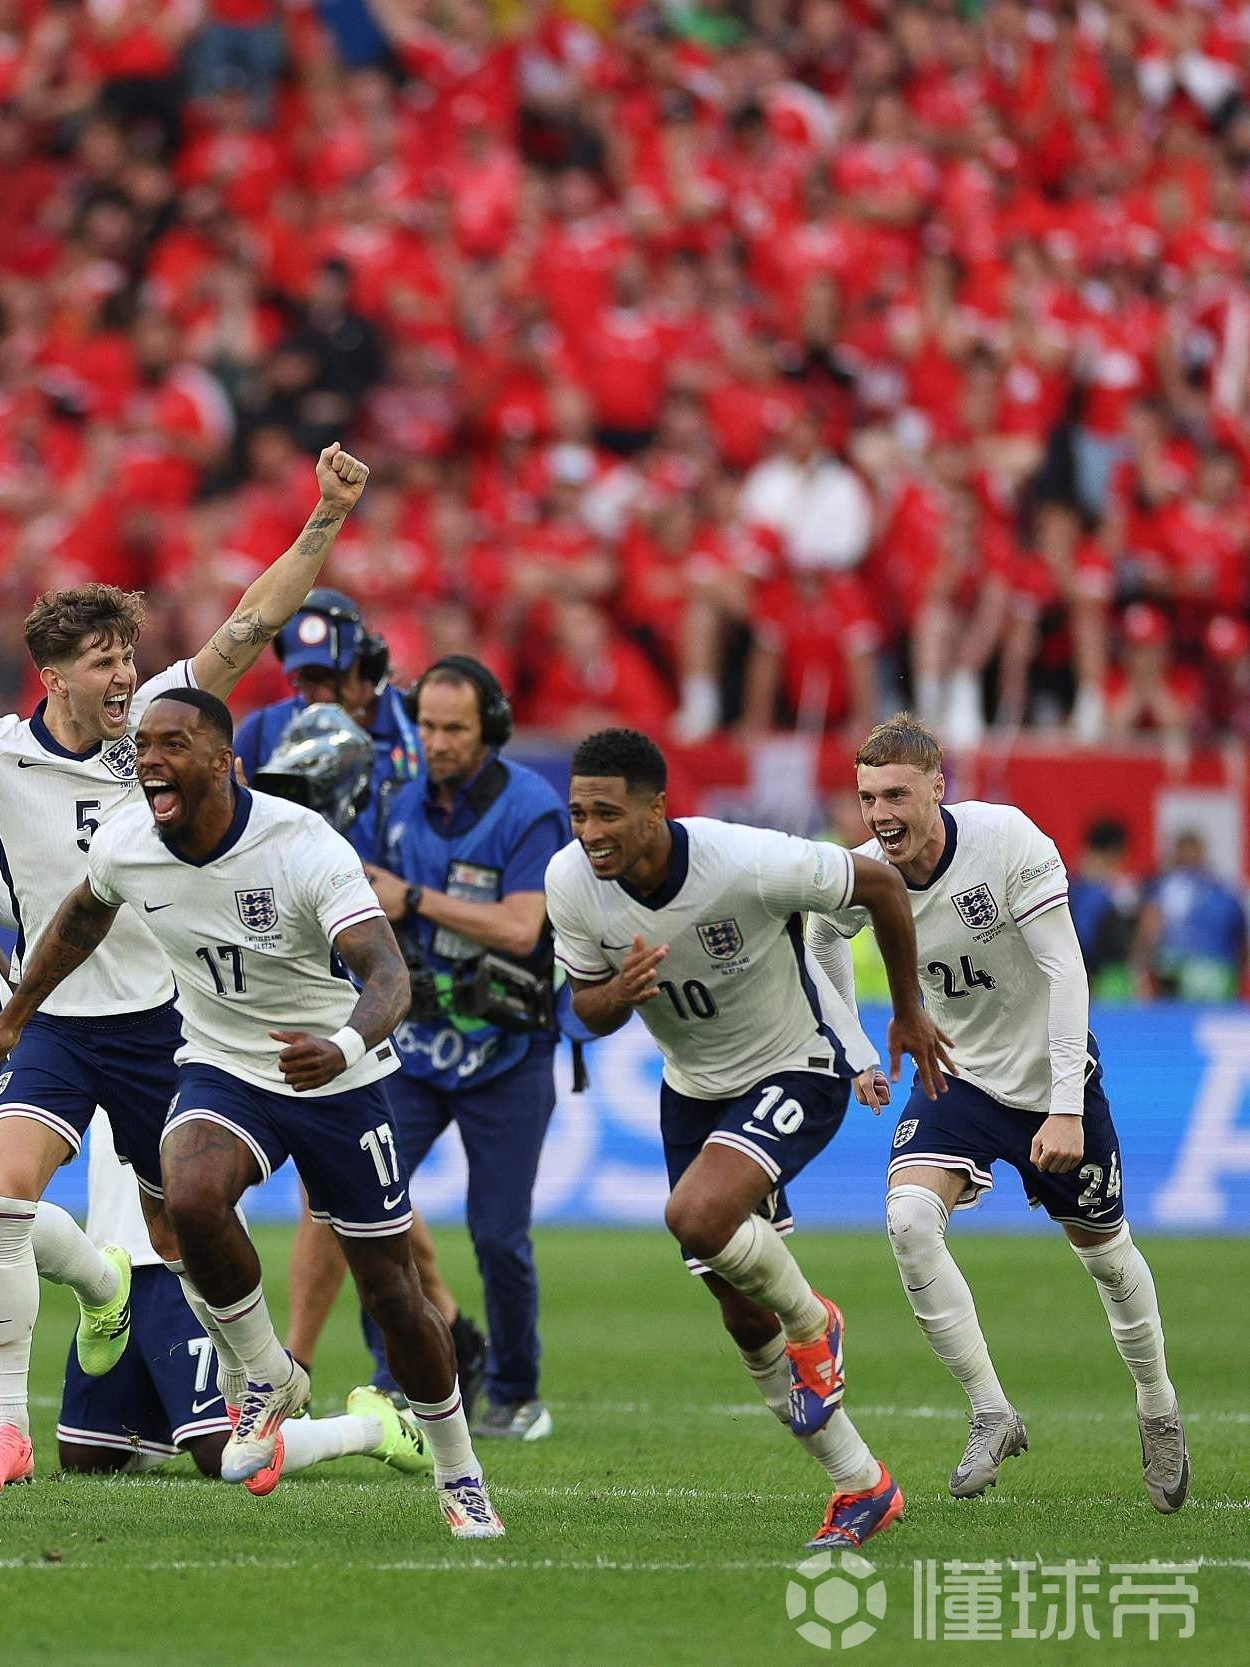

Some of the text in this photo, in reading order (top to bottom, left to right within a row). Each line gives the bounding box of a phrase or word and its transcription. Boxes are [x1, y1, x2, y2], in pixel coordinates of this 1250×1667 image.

[76, 800, 101, 853] 5
[195, 945, 247, 996] 17
[927, 955, 997, 999] 24
[656, 979, 719, 1020] 10
[752, 1085, 804, 1136] 10
[359, 1122, 400, 1187] 17
[1078, 1150, 1121, 1207] 24
[187, 1336, 213, 1392] 7
